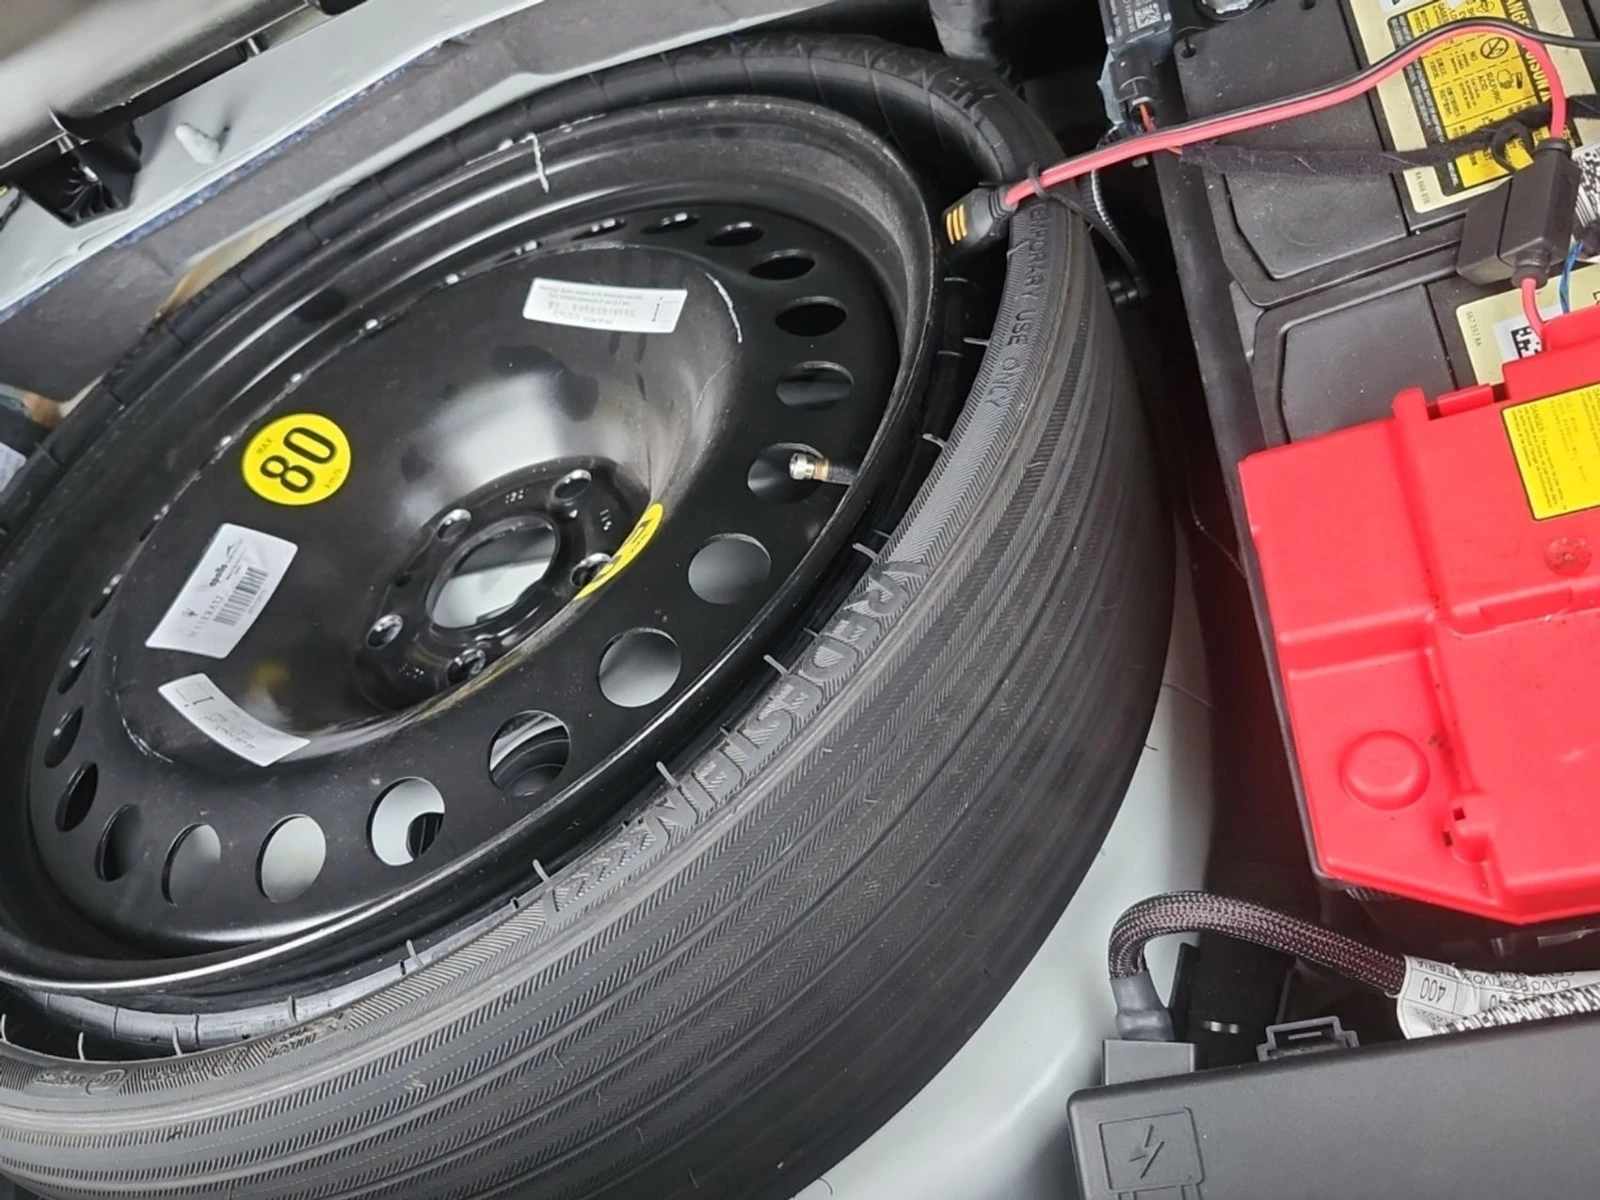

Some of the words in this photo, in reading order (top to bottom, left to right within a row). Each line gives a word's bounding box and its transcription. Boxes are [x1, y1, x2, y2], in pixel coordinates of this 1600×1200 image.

[1468, 50, 1478, 61] NO
[1477, 74, 1488, 91] ACID
[1485, 71, 1501, 104] SULFURIC
[1007, 309, 1034, 347] USE
[985, 355, 1019, 408] ONLY
[255, 435, 273, 456] MAX
[260, 427, 338, 493] 80
[206, 561, 229, 589] apollo
[1419, 976, 1447, 1003] 400
[1531, 979, 1571, 992] CAVO
